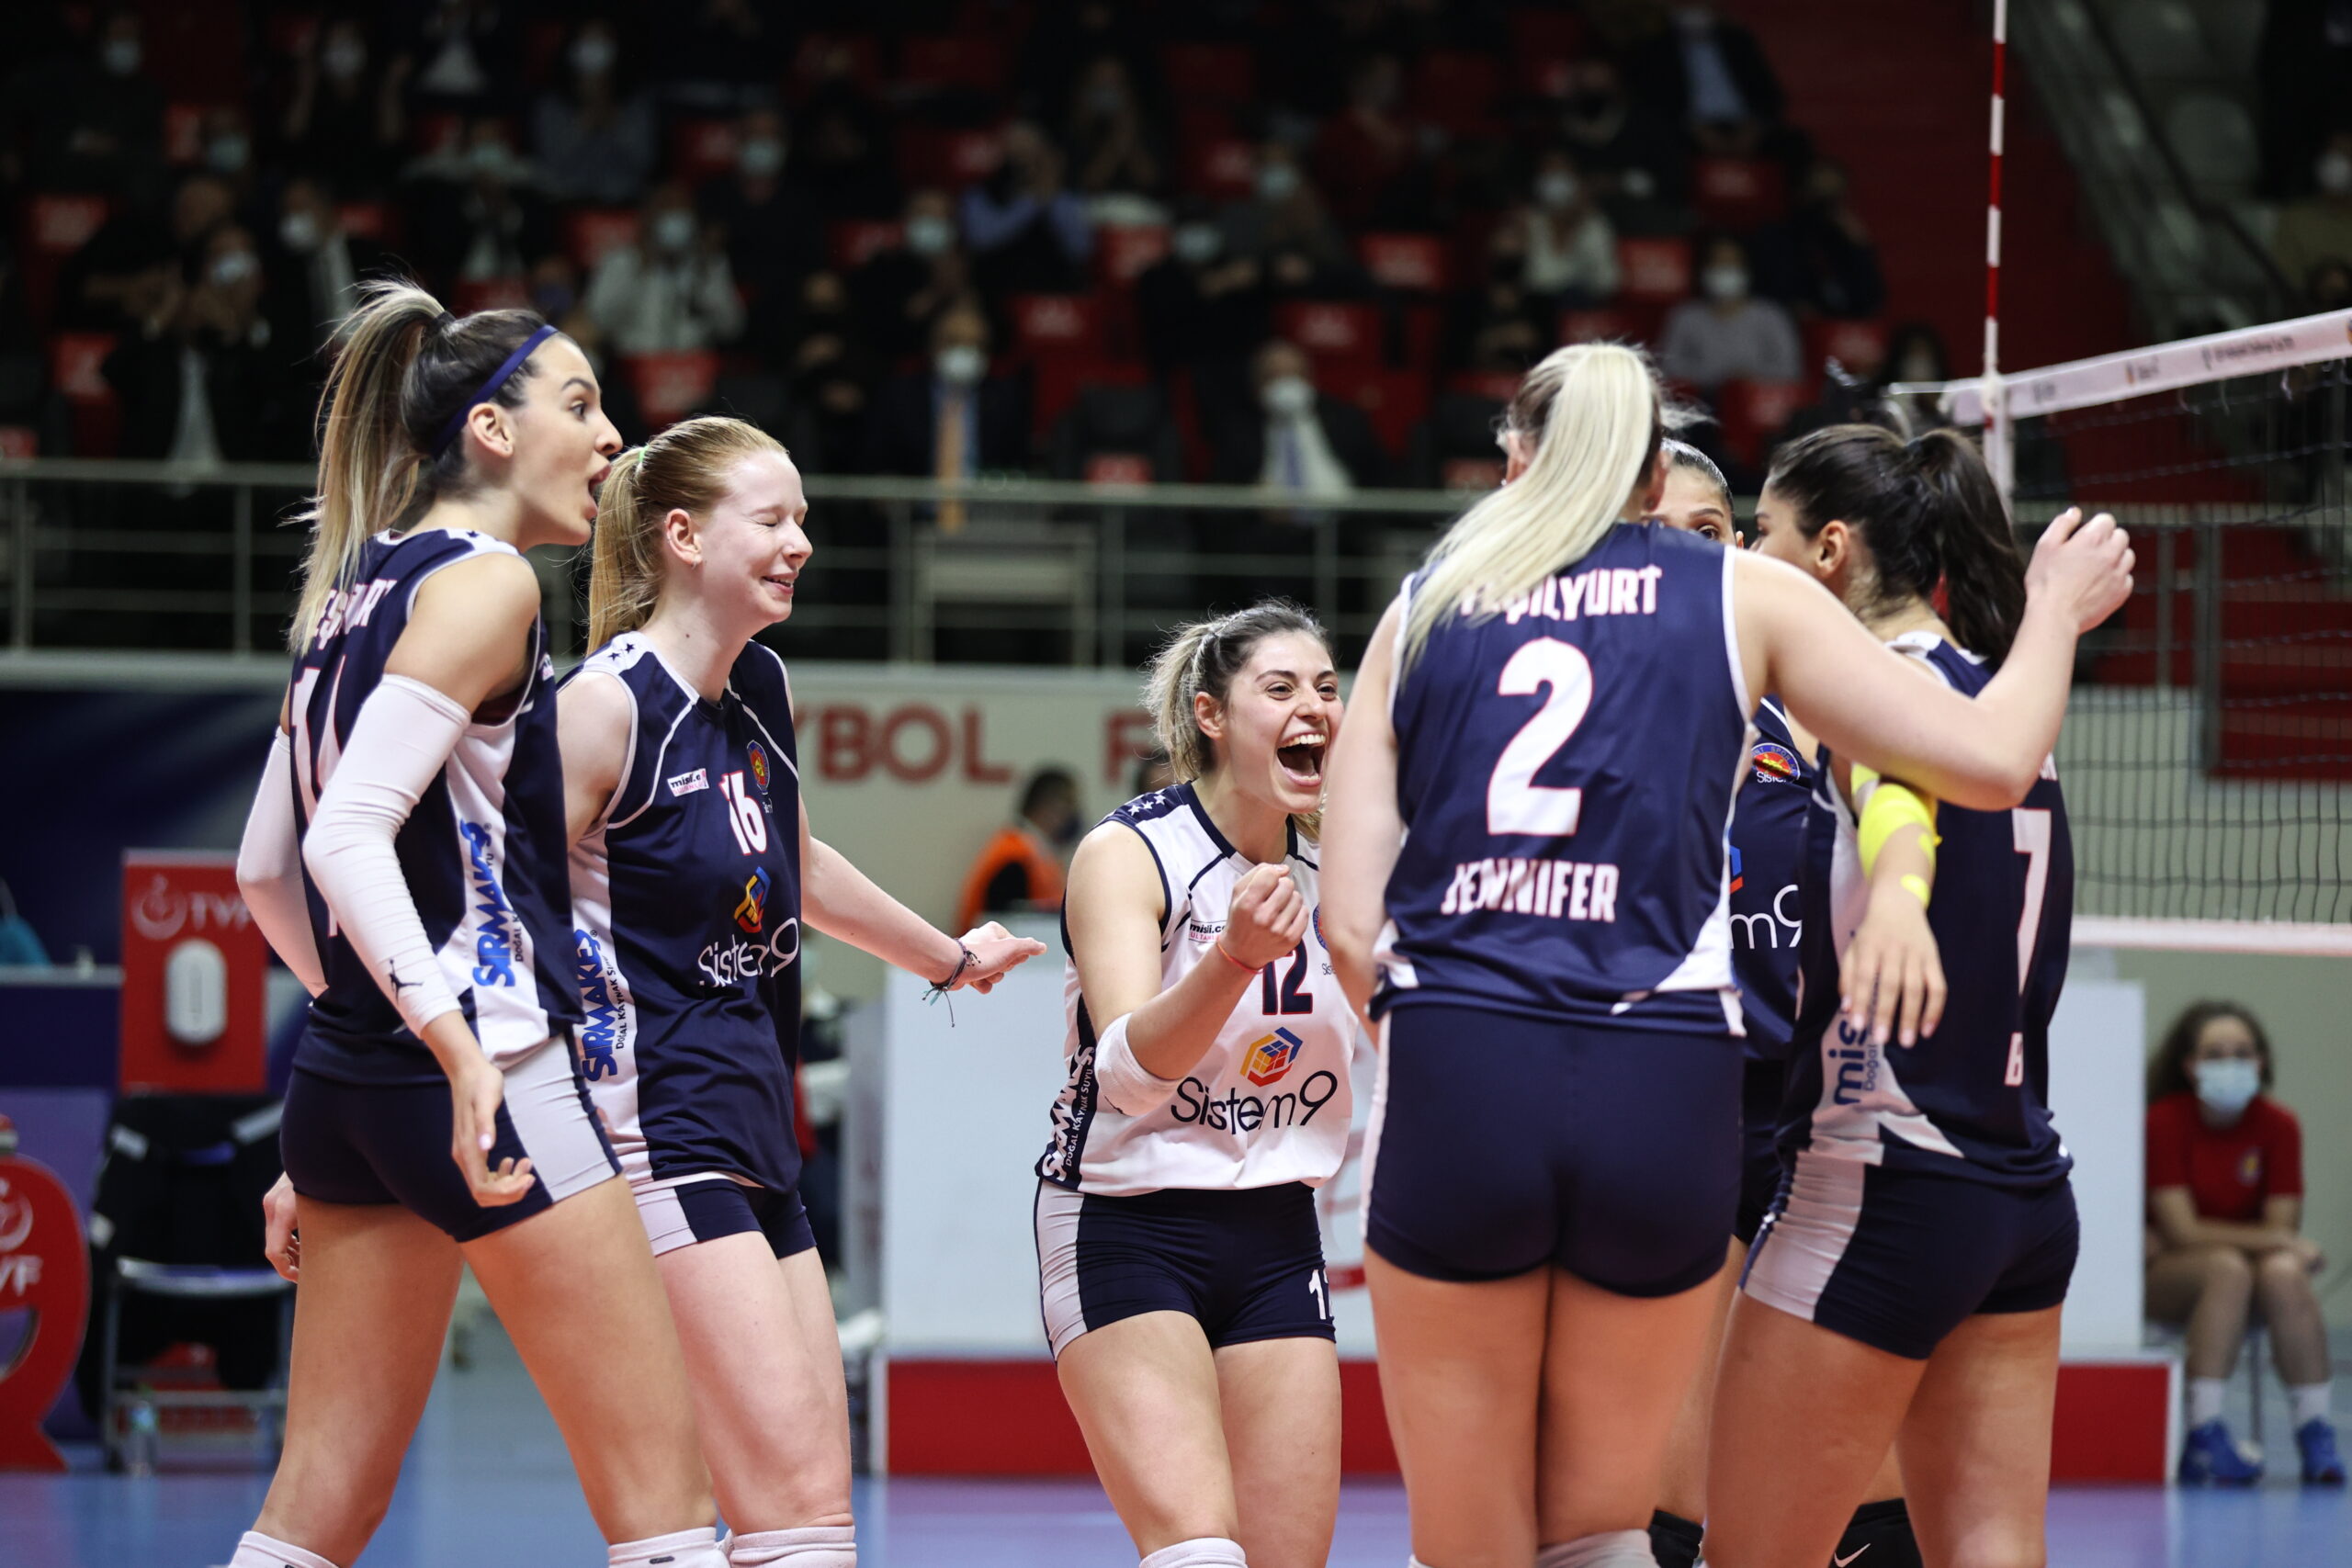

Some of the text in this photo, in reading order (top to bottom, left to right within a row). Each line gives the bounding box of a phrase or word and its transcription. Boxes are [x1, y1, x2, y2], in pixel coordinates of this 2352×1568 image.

[1487, 635, 1594, 837] 2
[718, 769, 767, 856] 16
[1440, 857, 1620, 923] JENNIFER
[1261, 937, 1314, 1016] 12
[1080, 1068, 1093, 1094] SUYU
[1170, 1069, 1339, 1135] Sistem9
